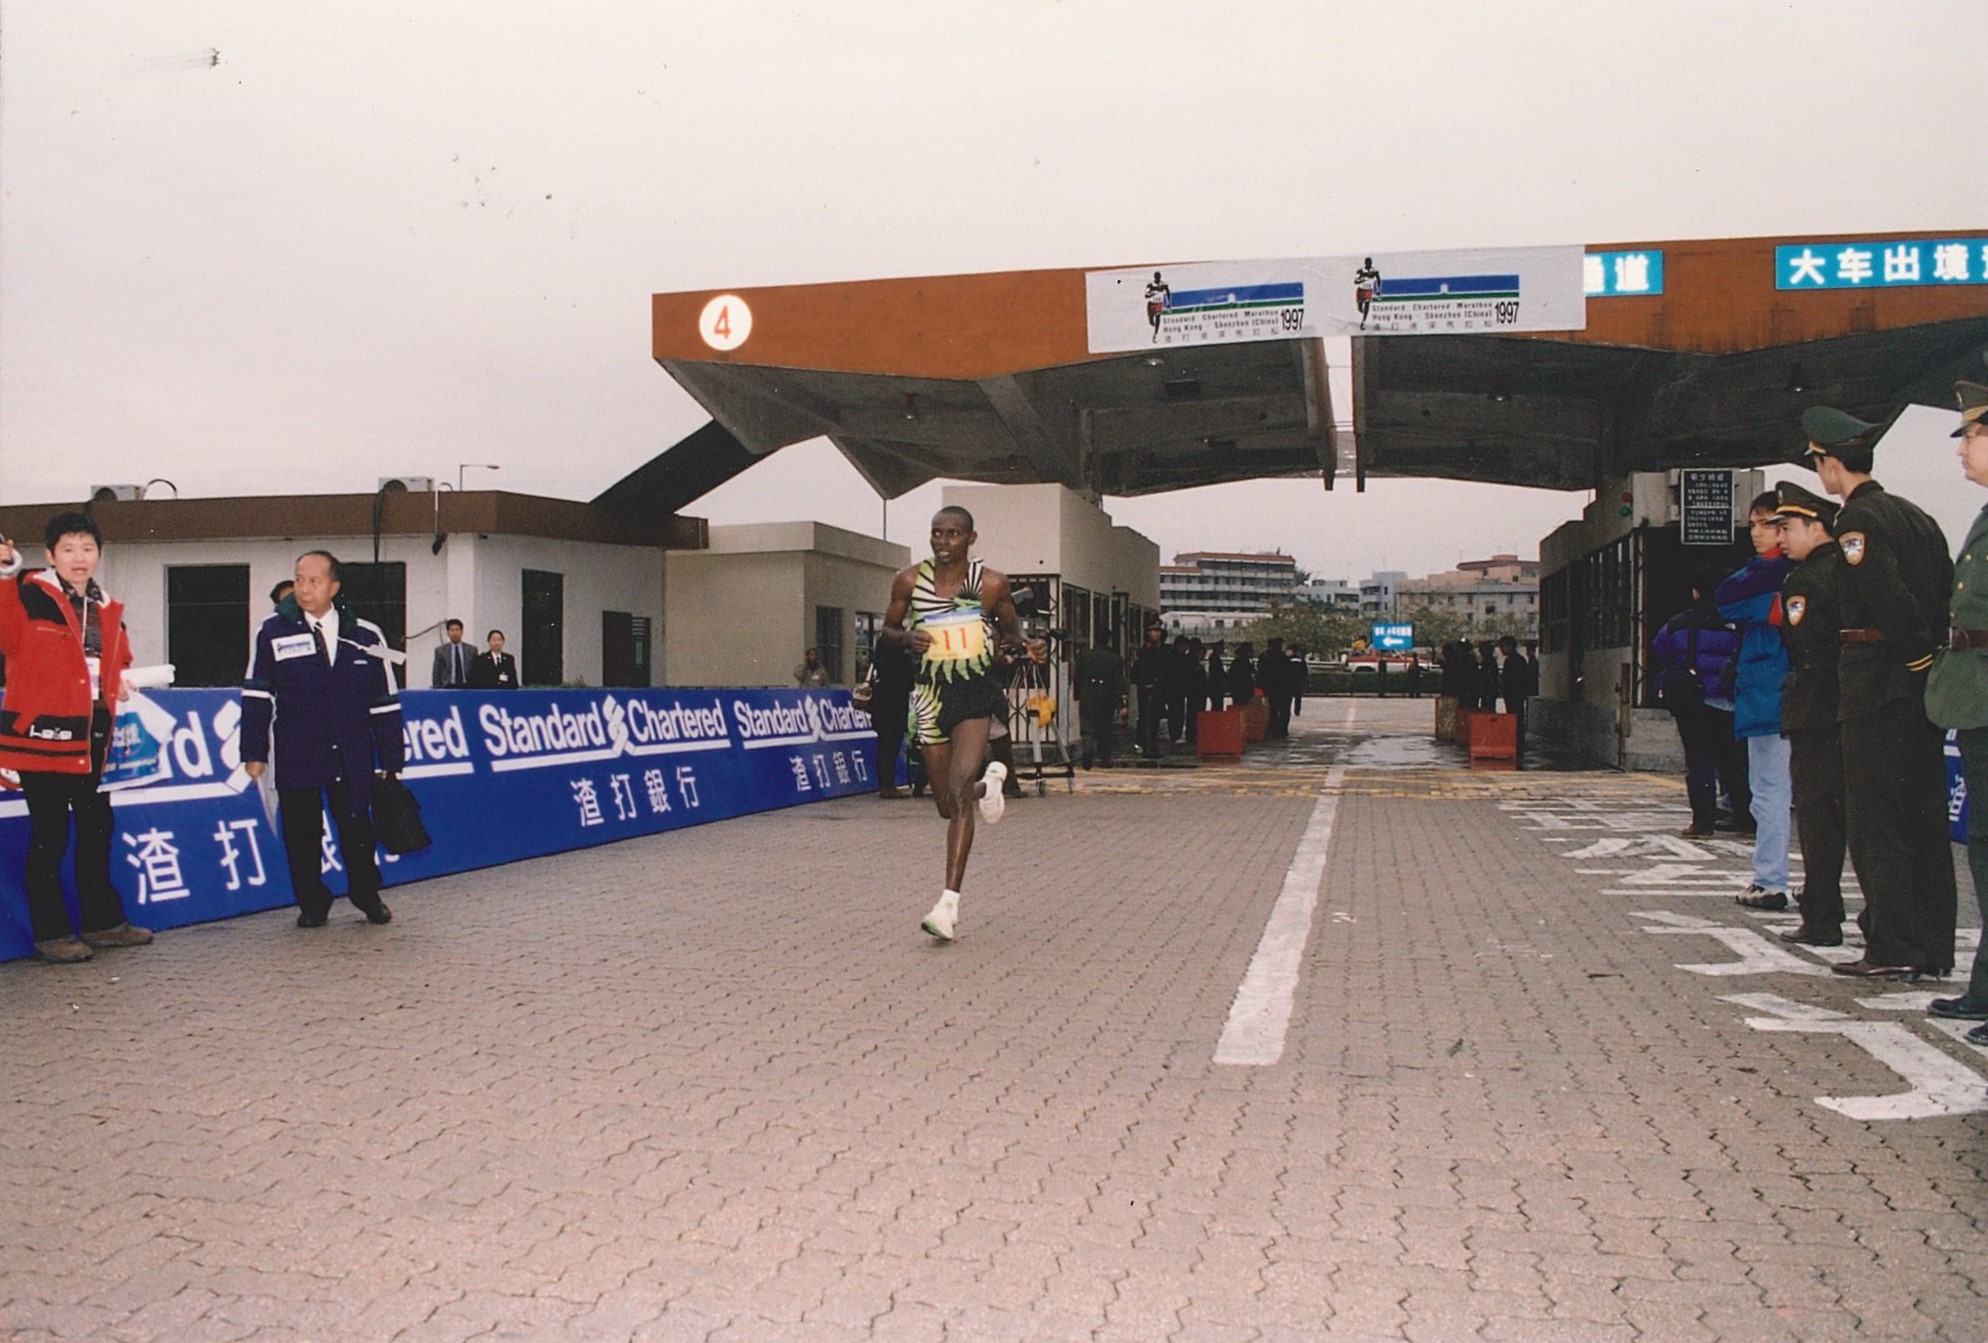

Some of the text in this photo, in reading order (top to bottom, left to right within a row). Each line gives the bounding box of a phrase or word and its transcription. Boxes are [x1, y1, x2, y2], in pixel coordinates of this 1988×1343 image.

[1202, 311, 1238, 321] Chartered
[1244, 309, 1279, 317] Marathon
[1393, 313, 1412, 321] Kong
[1412, 302, 1450, 311] Chartered
[1456, 301, 1492, 310] Marathon
[1495, 301, 1519, 324] 1997
[713, 305, 731, 339] 4
[1280, 308, 1304, 331] 1997
[943, 627, 966, 650] 11
[478, 702, 606, 757] Standard
[627, 698, 728, 743] Chartered
[733, 698, 872, 738] Standard Charter
[789, 750, 867, 791] 渣打銀行
[570, 766, 700, 827] 渣打銀行
